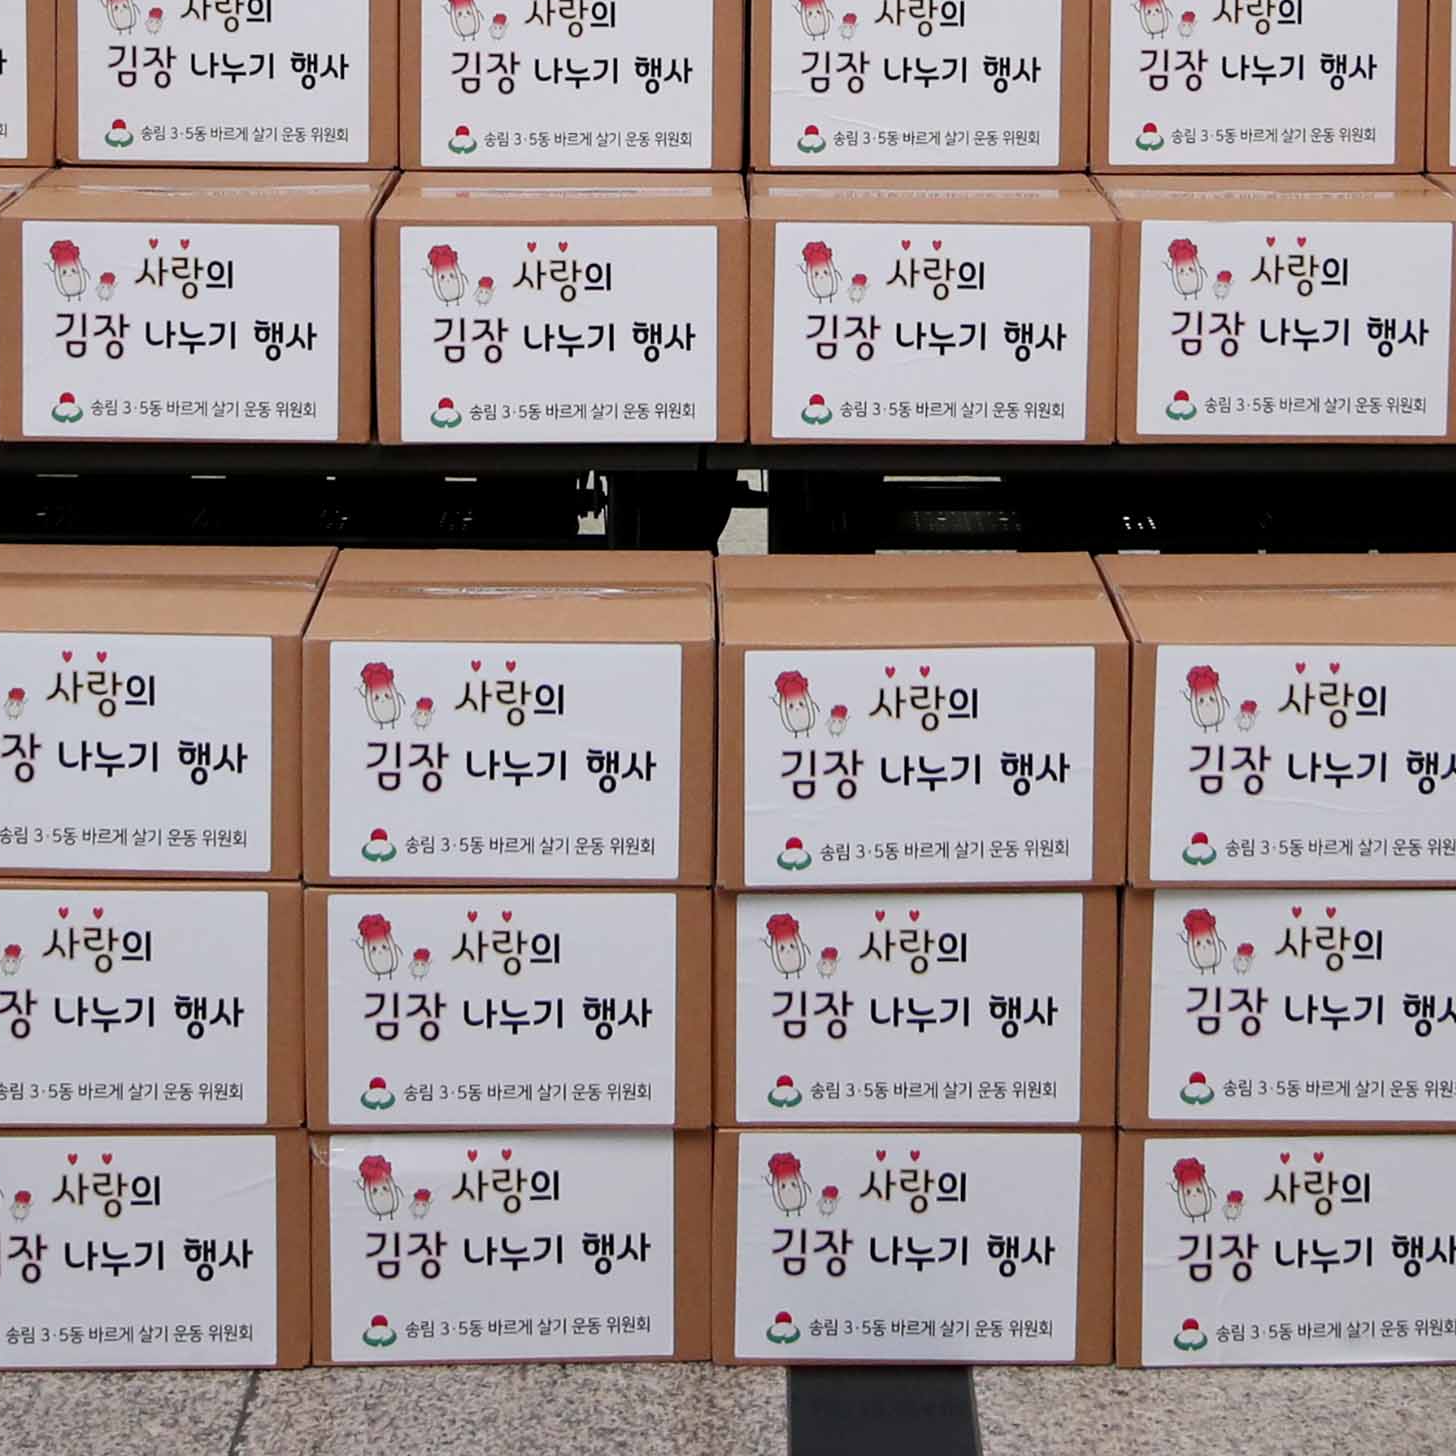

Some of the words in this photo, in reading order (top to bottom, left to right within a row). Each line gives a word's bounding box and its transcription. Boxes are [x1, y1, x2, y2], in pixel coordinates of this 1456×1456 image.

[886, 258, 984, 301] 사랑의
[806, 314, 882, 362] 김장
[896, 321, 986, 356] 나누기
[1003, 321, 1067, 362] 행사
[839, 400, 866, 417] 송림
[915, 401, 956, 418] 바르게
[960, 401, 987, 418] 살기
[991, 401, 1020, 419] 운동
[1023, 401, 1064, 419] 위원회
[451, 930, 560, 976] 사랑의
[364, 992, 447, 1042] 김장
[464, 998, 563, 1035] 나누기
[582, 996, 653, 1040] 행사
[403, 1083, 432, 1101] 송림
[487, 1083, 532, 1101] 바르게
[537, 1083, 566, 1101] 살기
[571, 1083, 602, 1101] 운동
[607, 1082, 651, 1101] 위원회
